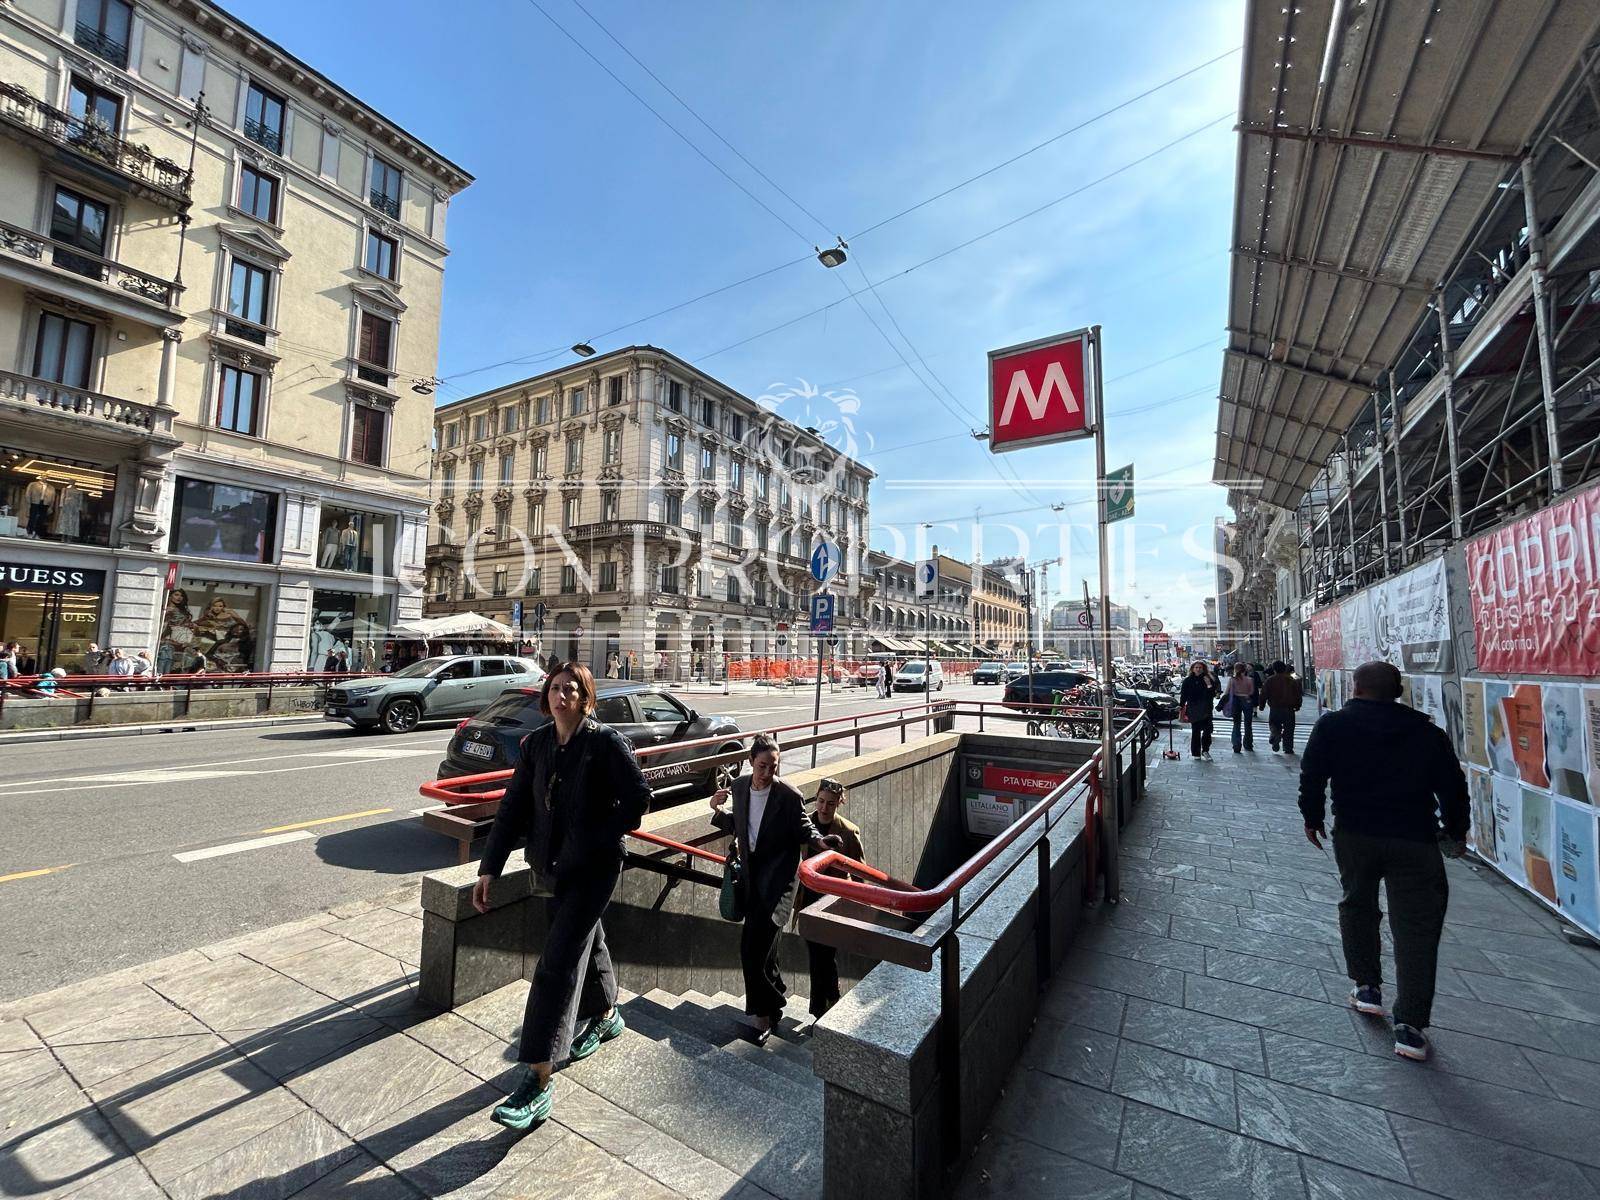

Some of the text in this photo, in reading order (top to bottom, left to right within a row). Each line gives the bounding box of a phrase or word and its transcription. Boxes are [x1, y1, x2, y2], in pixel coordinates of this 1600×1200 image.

[998, 361, 1080, 427] M
[1477, 512, 1600, 604] COPRI
[815, 598, 828, 619] P
[1003, 776, 1058, 789] P.TA VENEZIA
